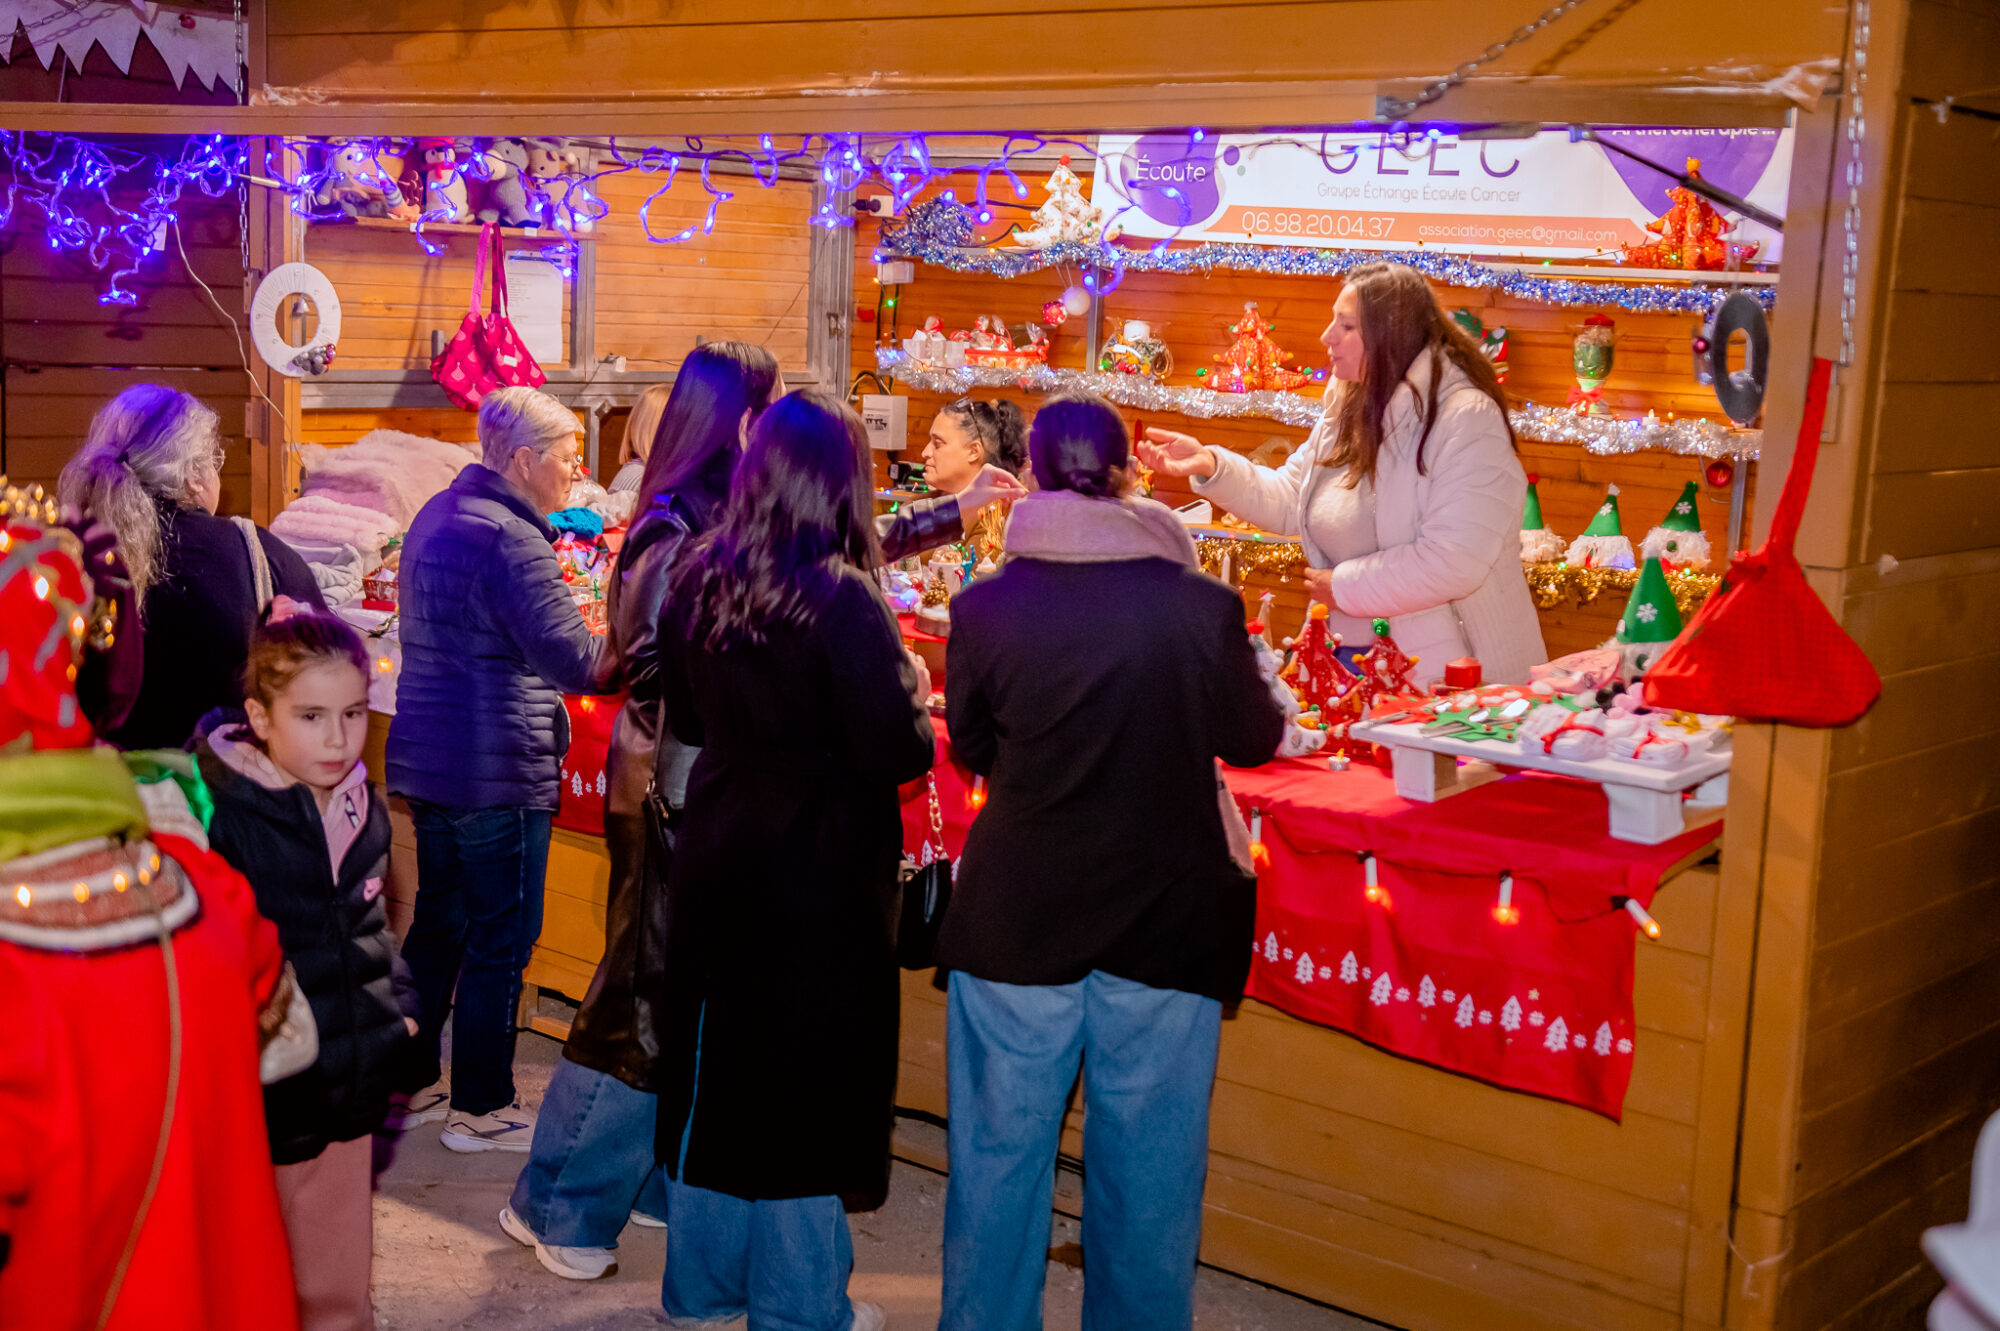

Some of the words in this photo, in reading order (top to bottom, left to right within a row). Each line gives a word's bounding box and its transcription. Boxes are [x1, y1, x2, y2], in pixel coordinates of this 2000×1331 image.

[1136, 154, 1206, 182] Écoute
[1317, 182, 1361, 201] Groupe
[1364, 181, 1418, 203] Échange
[1423, 183, 1467, 200] Écoute
[1470, 187, 1521, 203] Cancer
[1241, 211, 1395, 238] 06.98.20.04.37
[1418, 224, 1617, 244] association.geec@gmail.com
